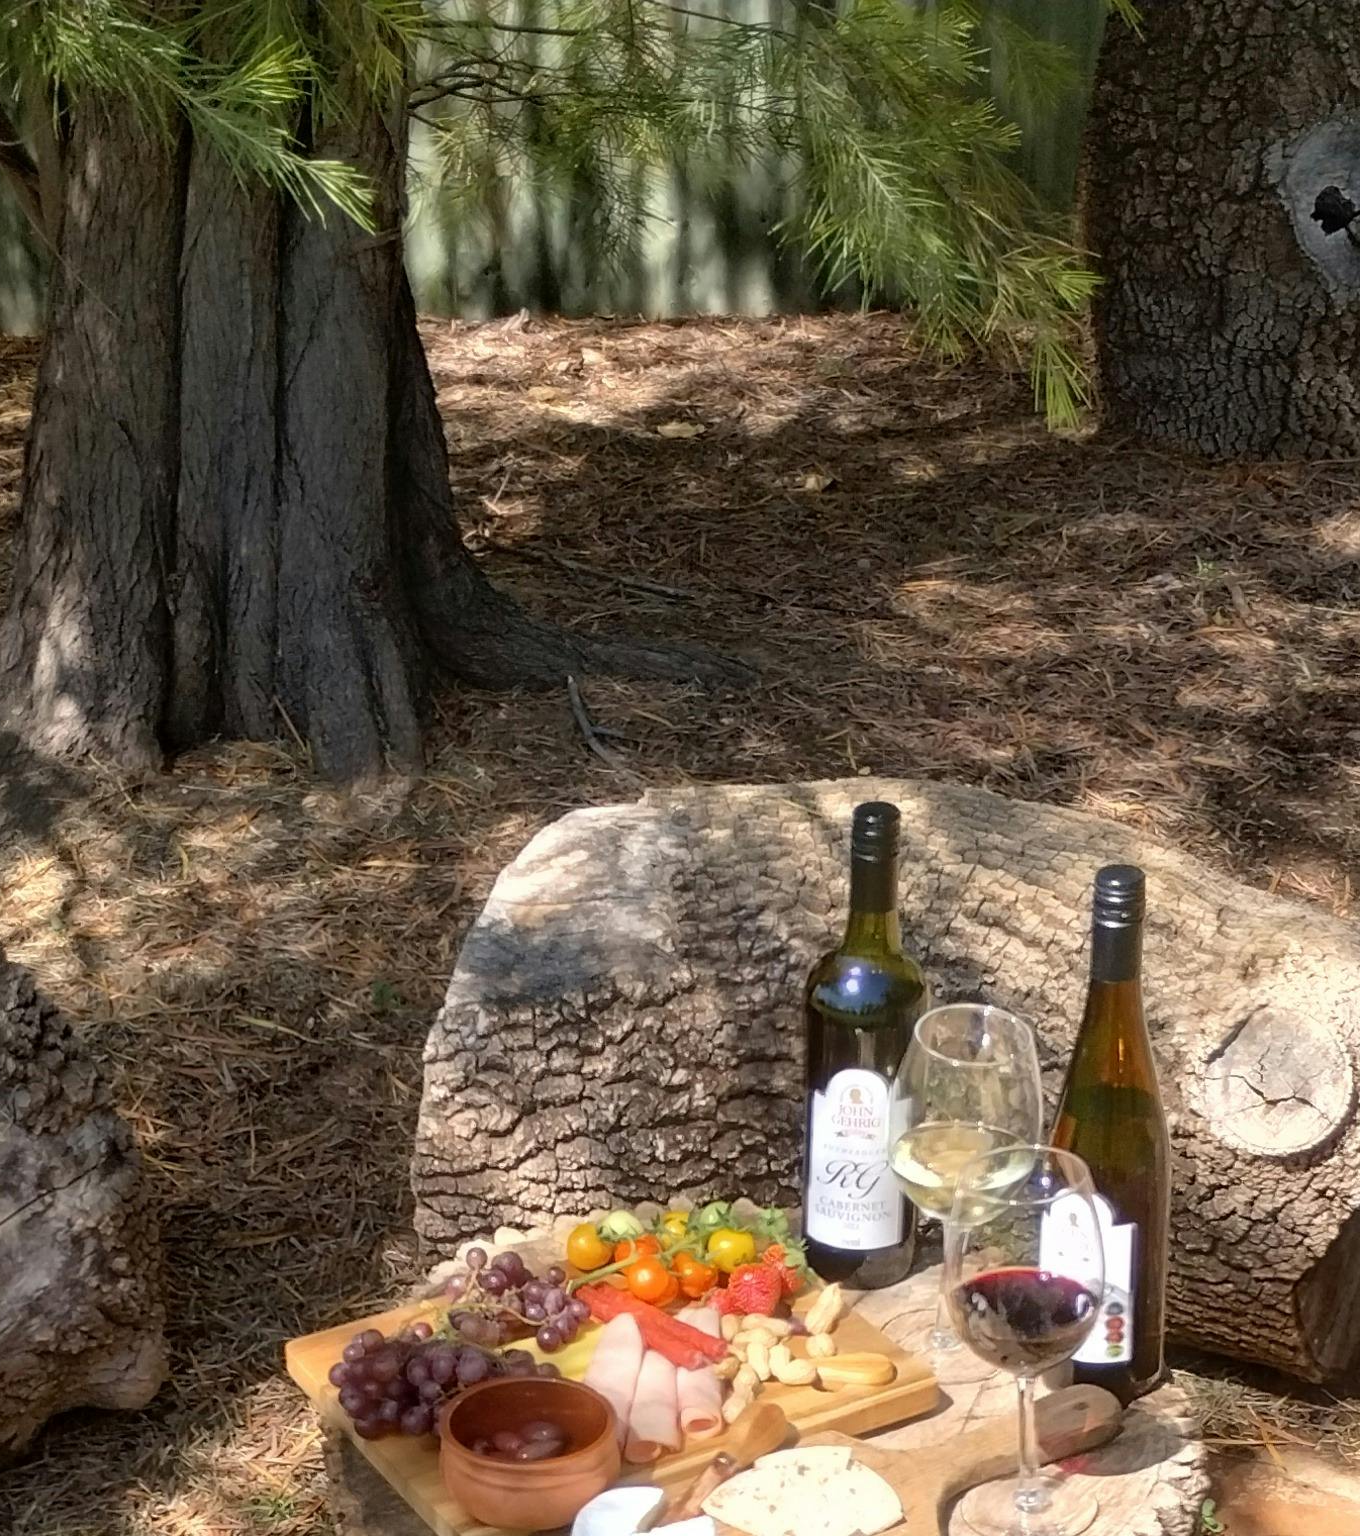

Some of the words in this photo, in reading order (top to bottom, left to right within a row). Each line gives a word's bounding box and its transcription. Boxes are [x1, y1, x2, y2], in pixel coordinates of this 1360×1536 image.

[838, 1104, 874, 1117] JOHN
[831, 1114, 881, 1128] GEHRIG
[816, 1159, 889, 1200] RG
[819, 1195, 887, 1211] CABERNET
[814, 1203, 892, 1222] SAUVIGNON
